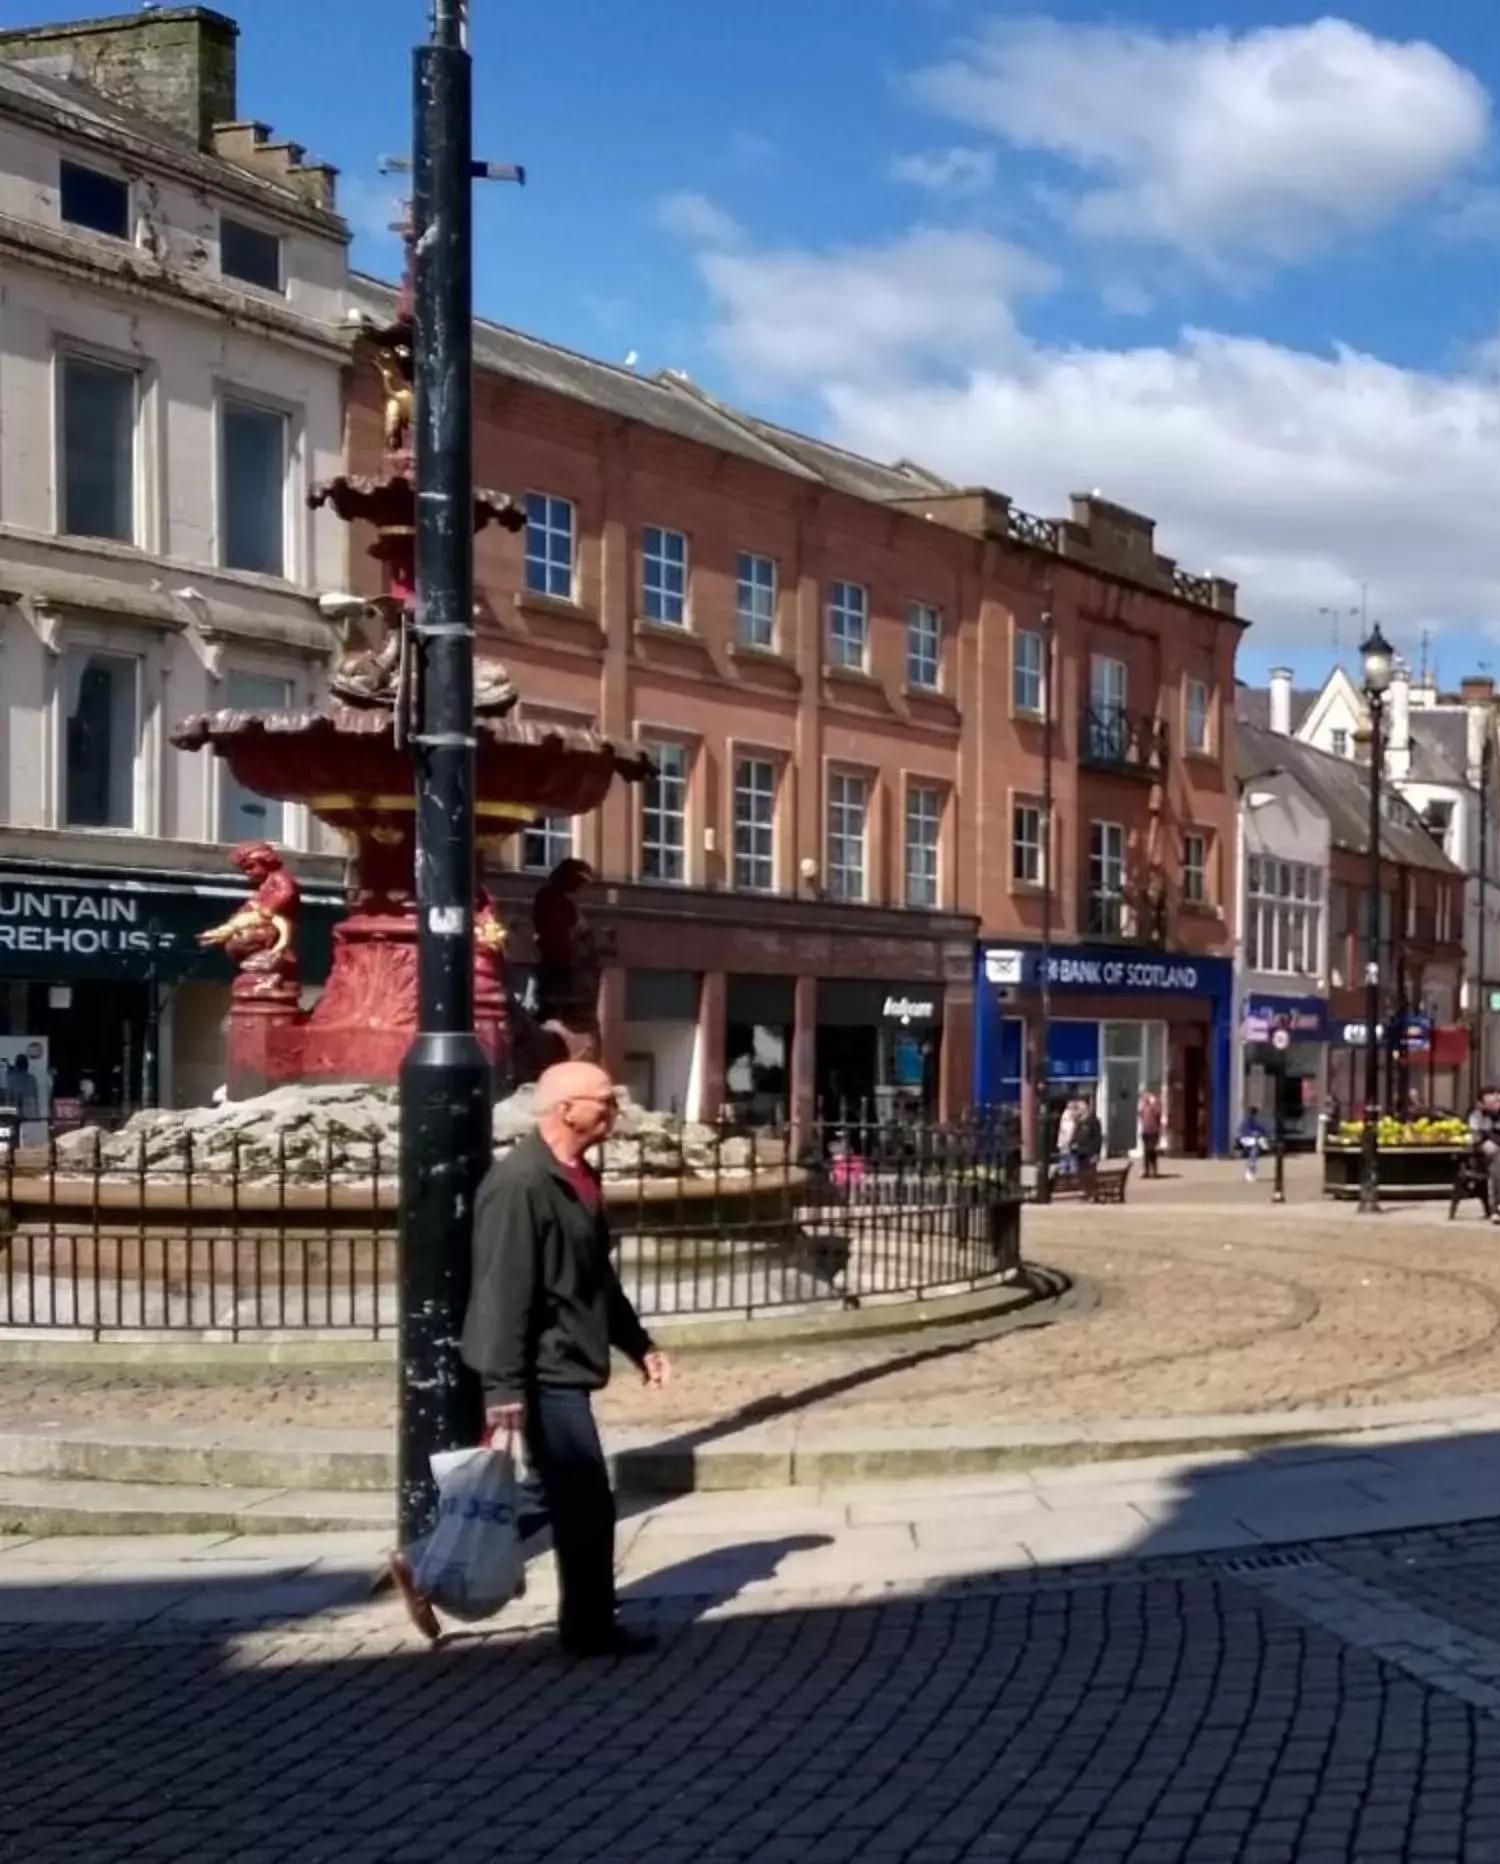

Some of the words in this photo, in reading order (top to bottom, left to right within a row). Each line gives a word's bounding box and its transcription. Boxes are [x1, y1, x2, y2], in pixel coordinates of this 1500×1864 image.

[0, 891, 137, 922] UNTAIN
[1060, 958, 1101, 983] BANK
[1103, 961, 1124, 984] OF
[1126, 962, 1198, 988] SCOTLAND
